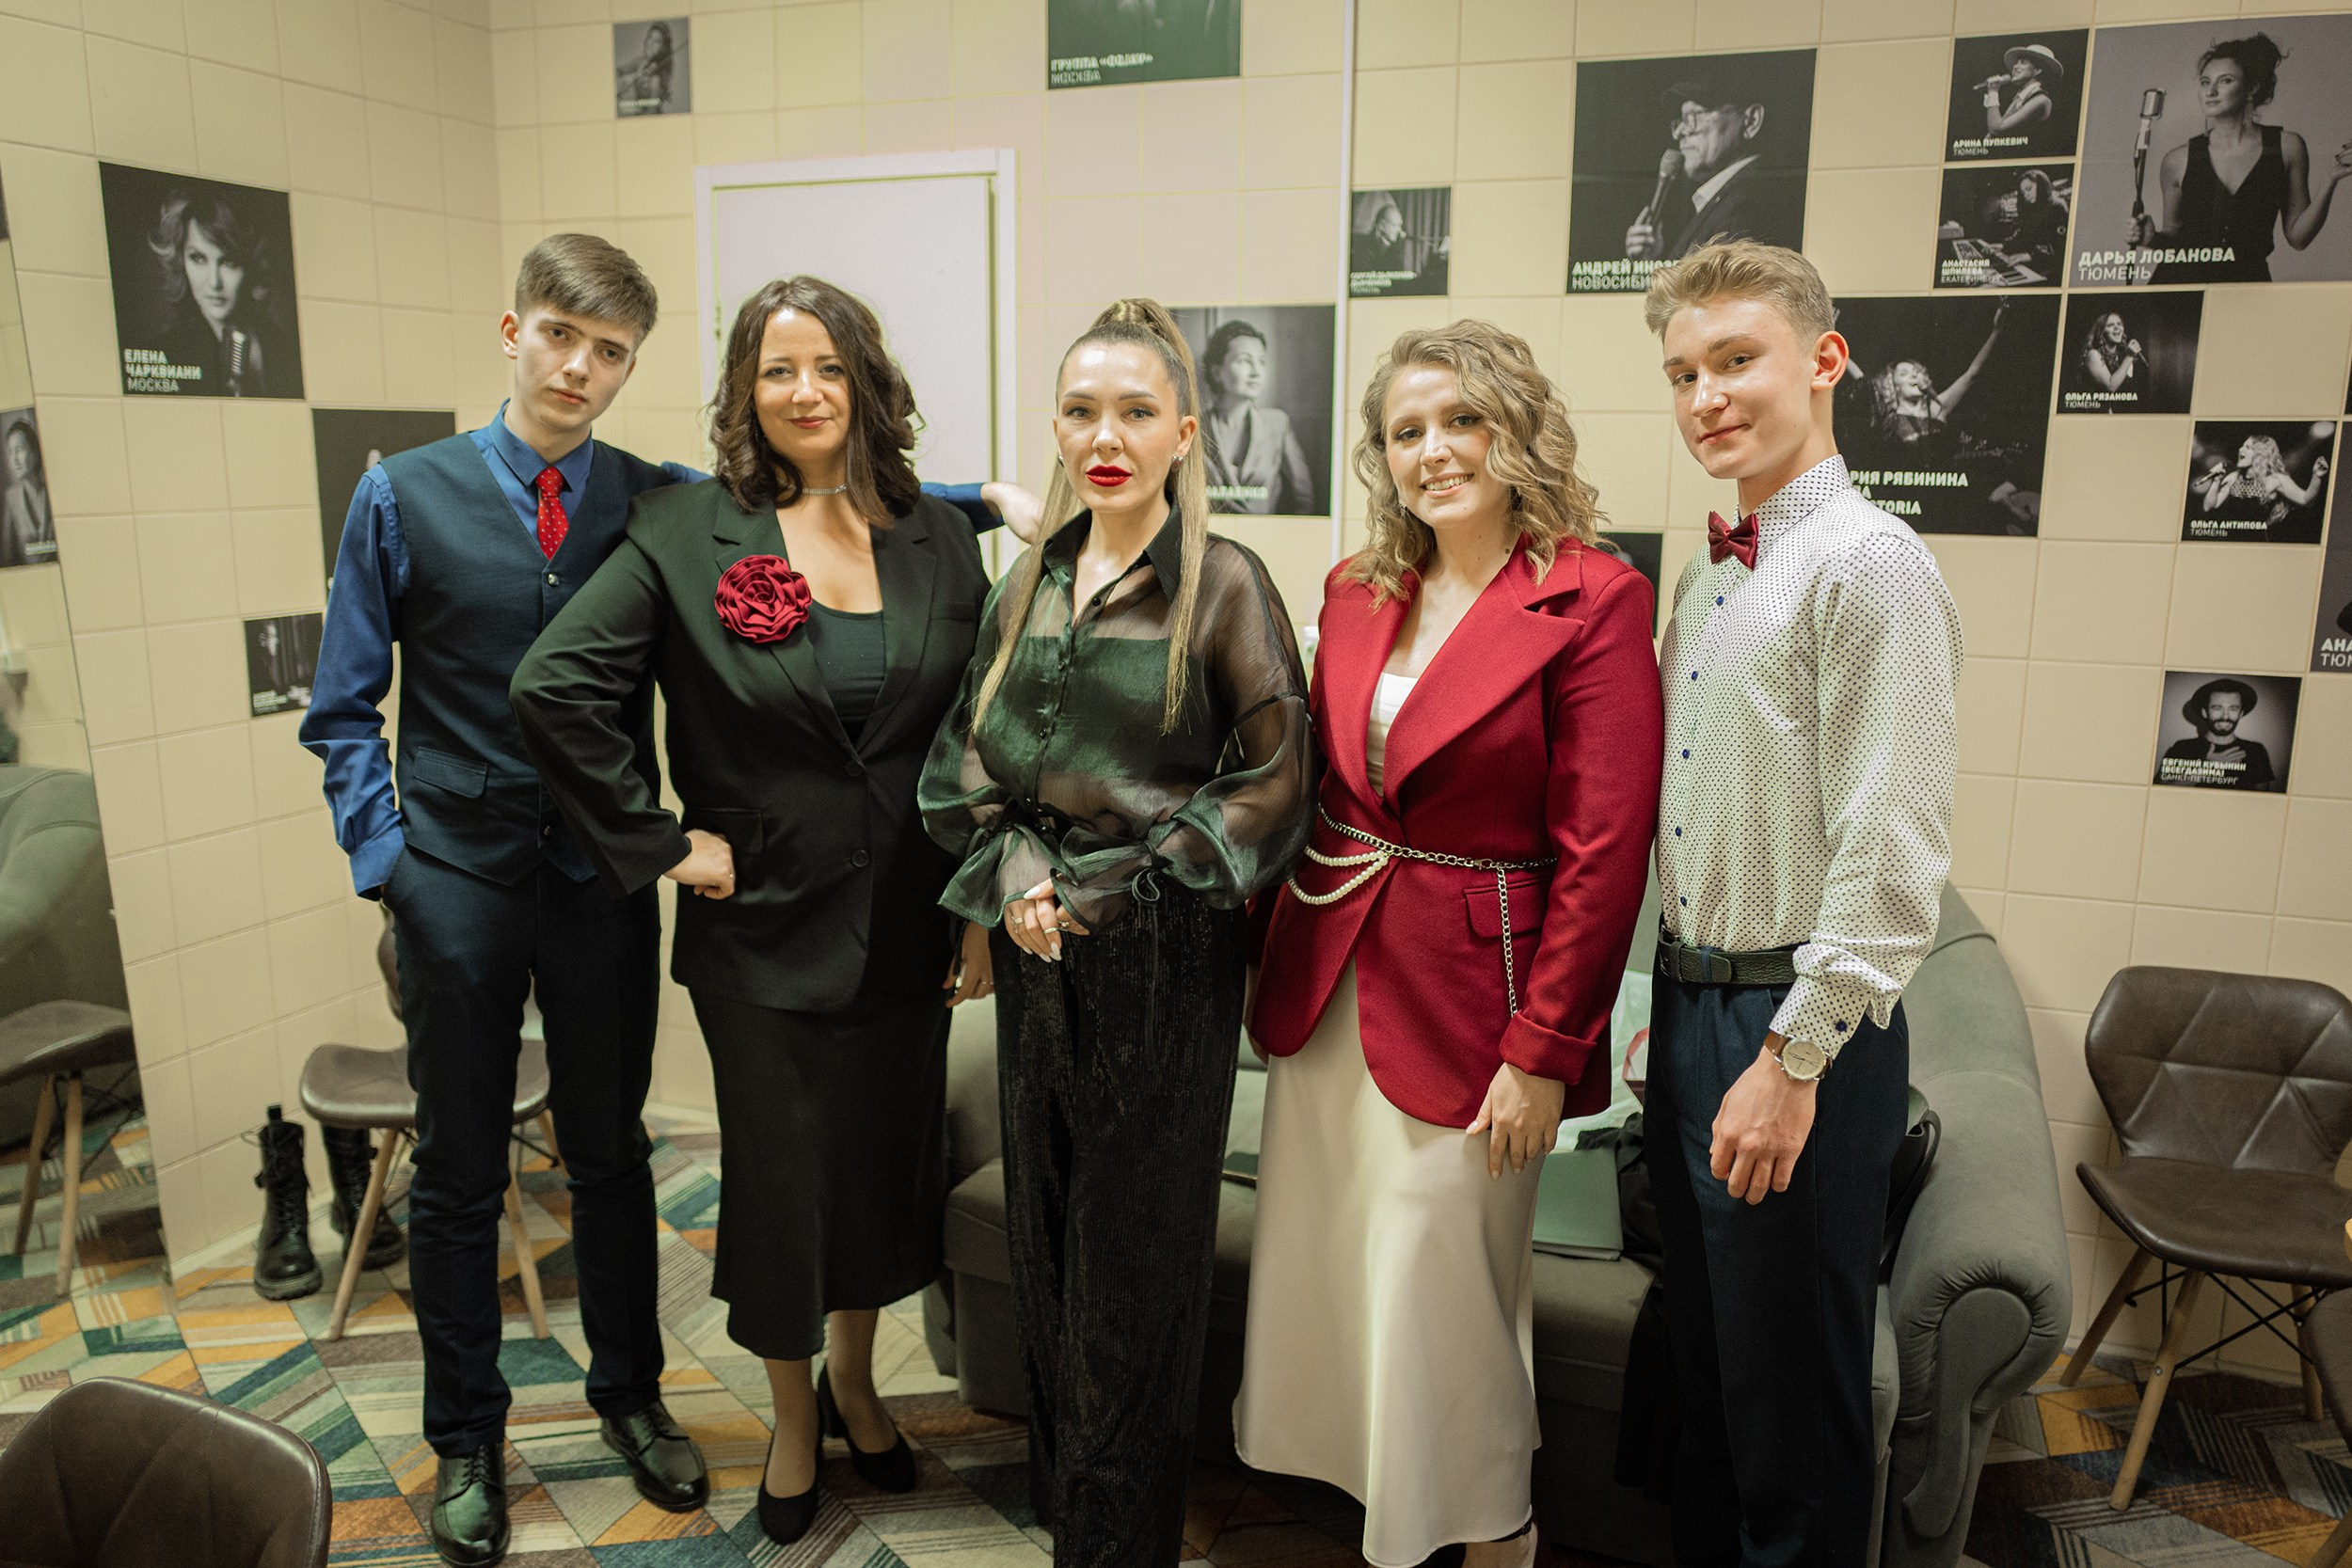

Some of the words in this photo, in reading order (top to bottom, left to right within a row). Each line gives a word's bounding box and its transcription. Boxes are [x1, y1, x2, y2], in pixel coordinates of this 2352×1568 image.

[1050, 55, 1100, 72] ГРУППА
[1051, 70, 1102, 85] МОСКВА
[1953, 139, 1982, 149] АРИНА
[1982, 136, 2029, 147] ПУПКЕВИЧ
[1953, 147, 1989, 156] ТЮМЕНЬ
[1942, 259, 1991, 268] АНАСТАСИЯ
[2078, 250, 2137, 267] ДАРЬЯ
[2139, 246, 2236, 265] ЛОБАНОВА
[1572, 258, 1631, 276] АНДРЕЙ
[2079, 265, 2152, 281] ТЮМЕНЬ
[124, 348, 168, 364] ЕЛЕНА
[125, 363, 202, 380] ЧАРКВИАНИ
[128, 377, 180, 392] МОСКВА
[2065, 392, 2091, 402] ОЛЬГА
[2093, 392, 2138, 402] РЯЗАНОВА
[2065, 401, 2102, 409] ТЮМЕНЬ
[1883, 471, 1968, 487] РЯБИНИНА
[2190, 520, 2219, 530] ОЛЬГА
[2219, 520, 2268, 531] АНТИПОВА
[2190, 529, 2229, 537] ТЮМЕНЬ
[2162, 757, 2201, 768] ЕВГЕНИЙ
[2160, 773, 2239, 785] САНКТ-ПЕТЕРБУРГ
